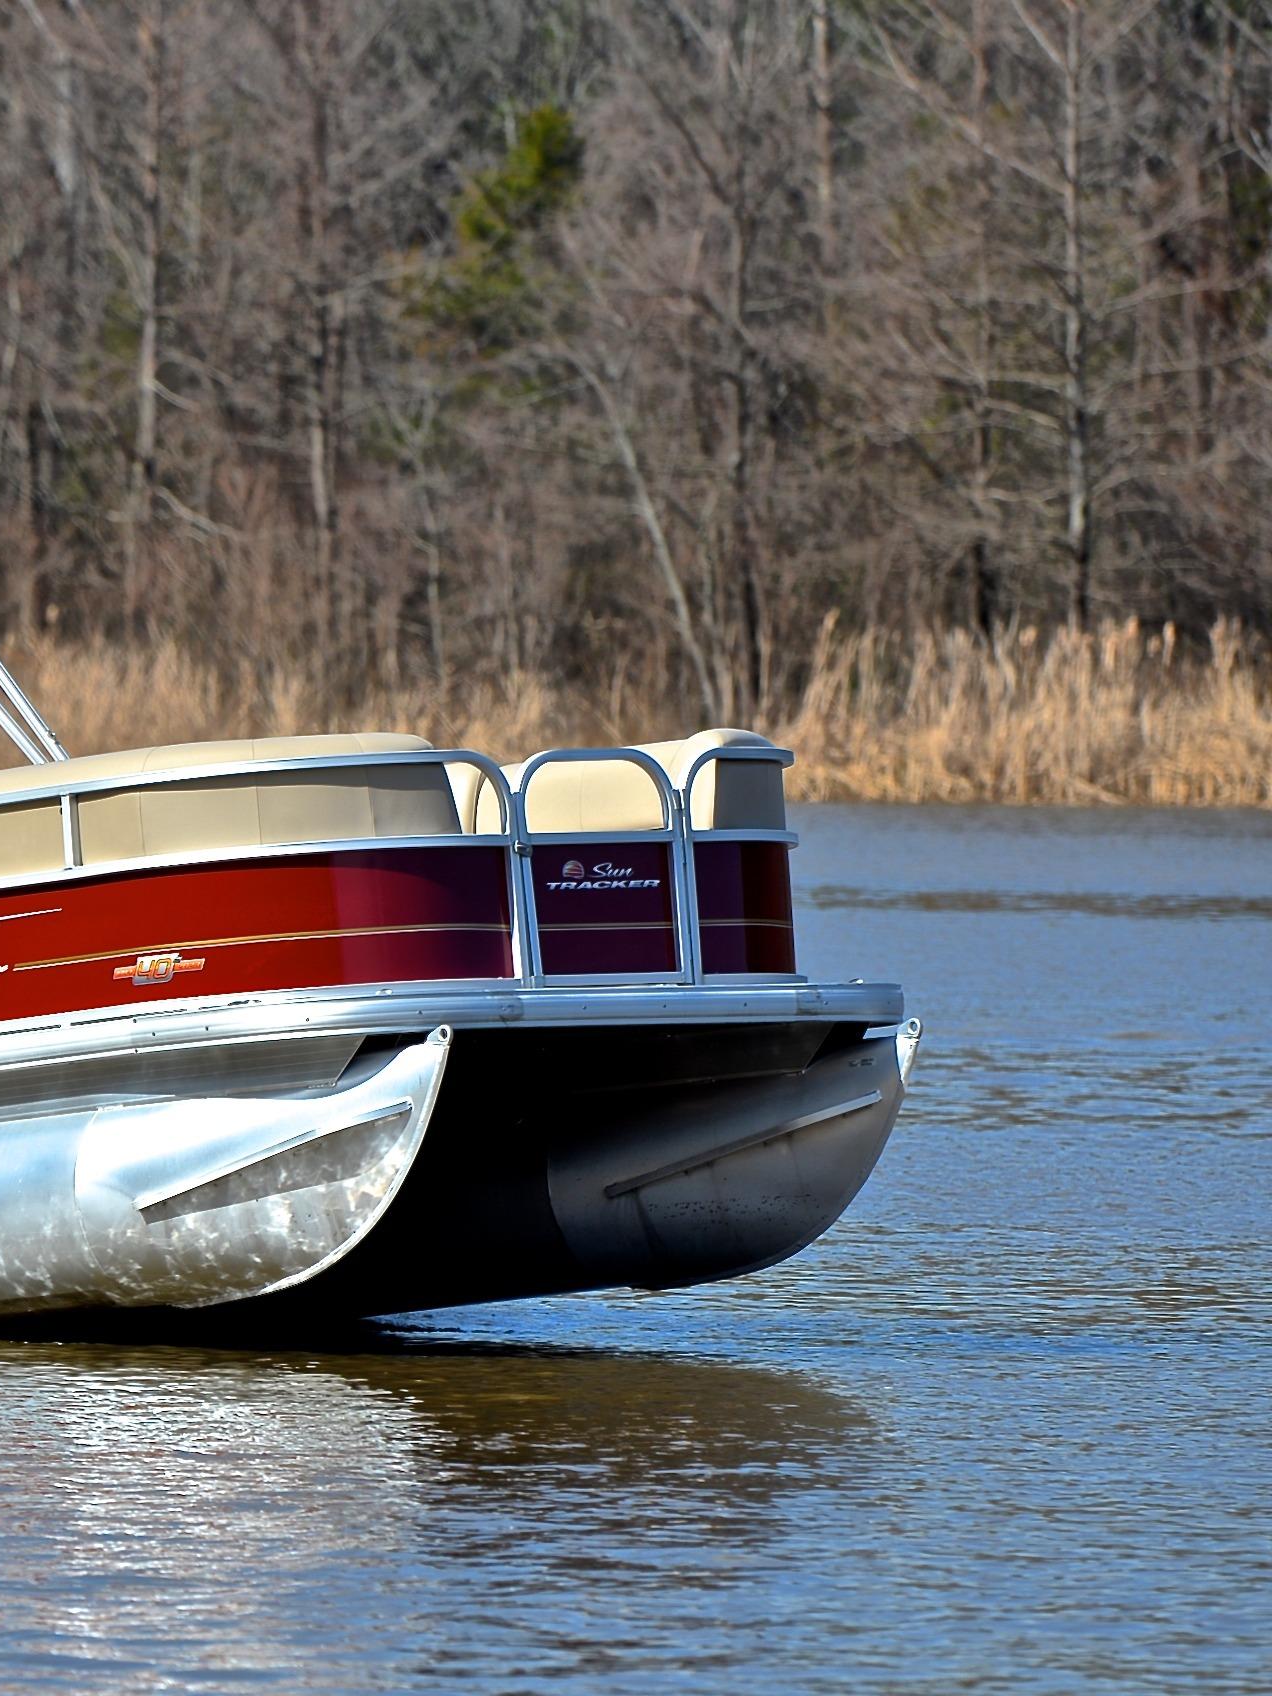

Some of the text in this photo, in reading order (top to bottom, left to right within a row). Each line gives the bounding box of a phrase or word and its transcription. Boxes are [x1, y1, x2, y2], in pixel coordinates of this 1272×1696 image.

[586, 862, 633, 878] Sun
[546, 879, 661, 890] TRACKER
[136, 957, 172, 979] 40
